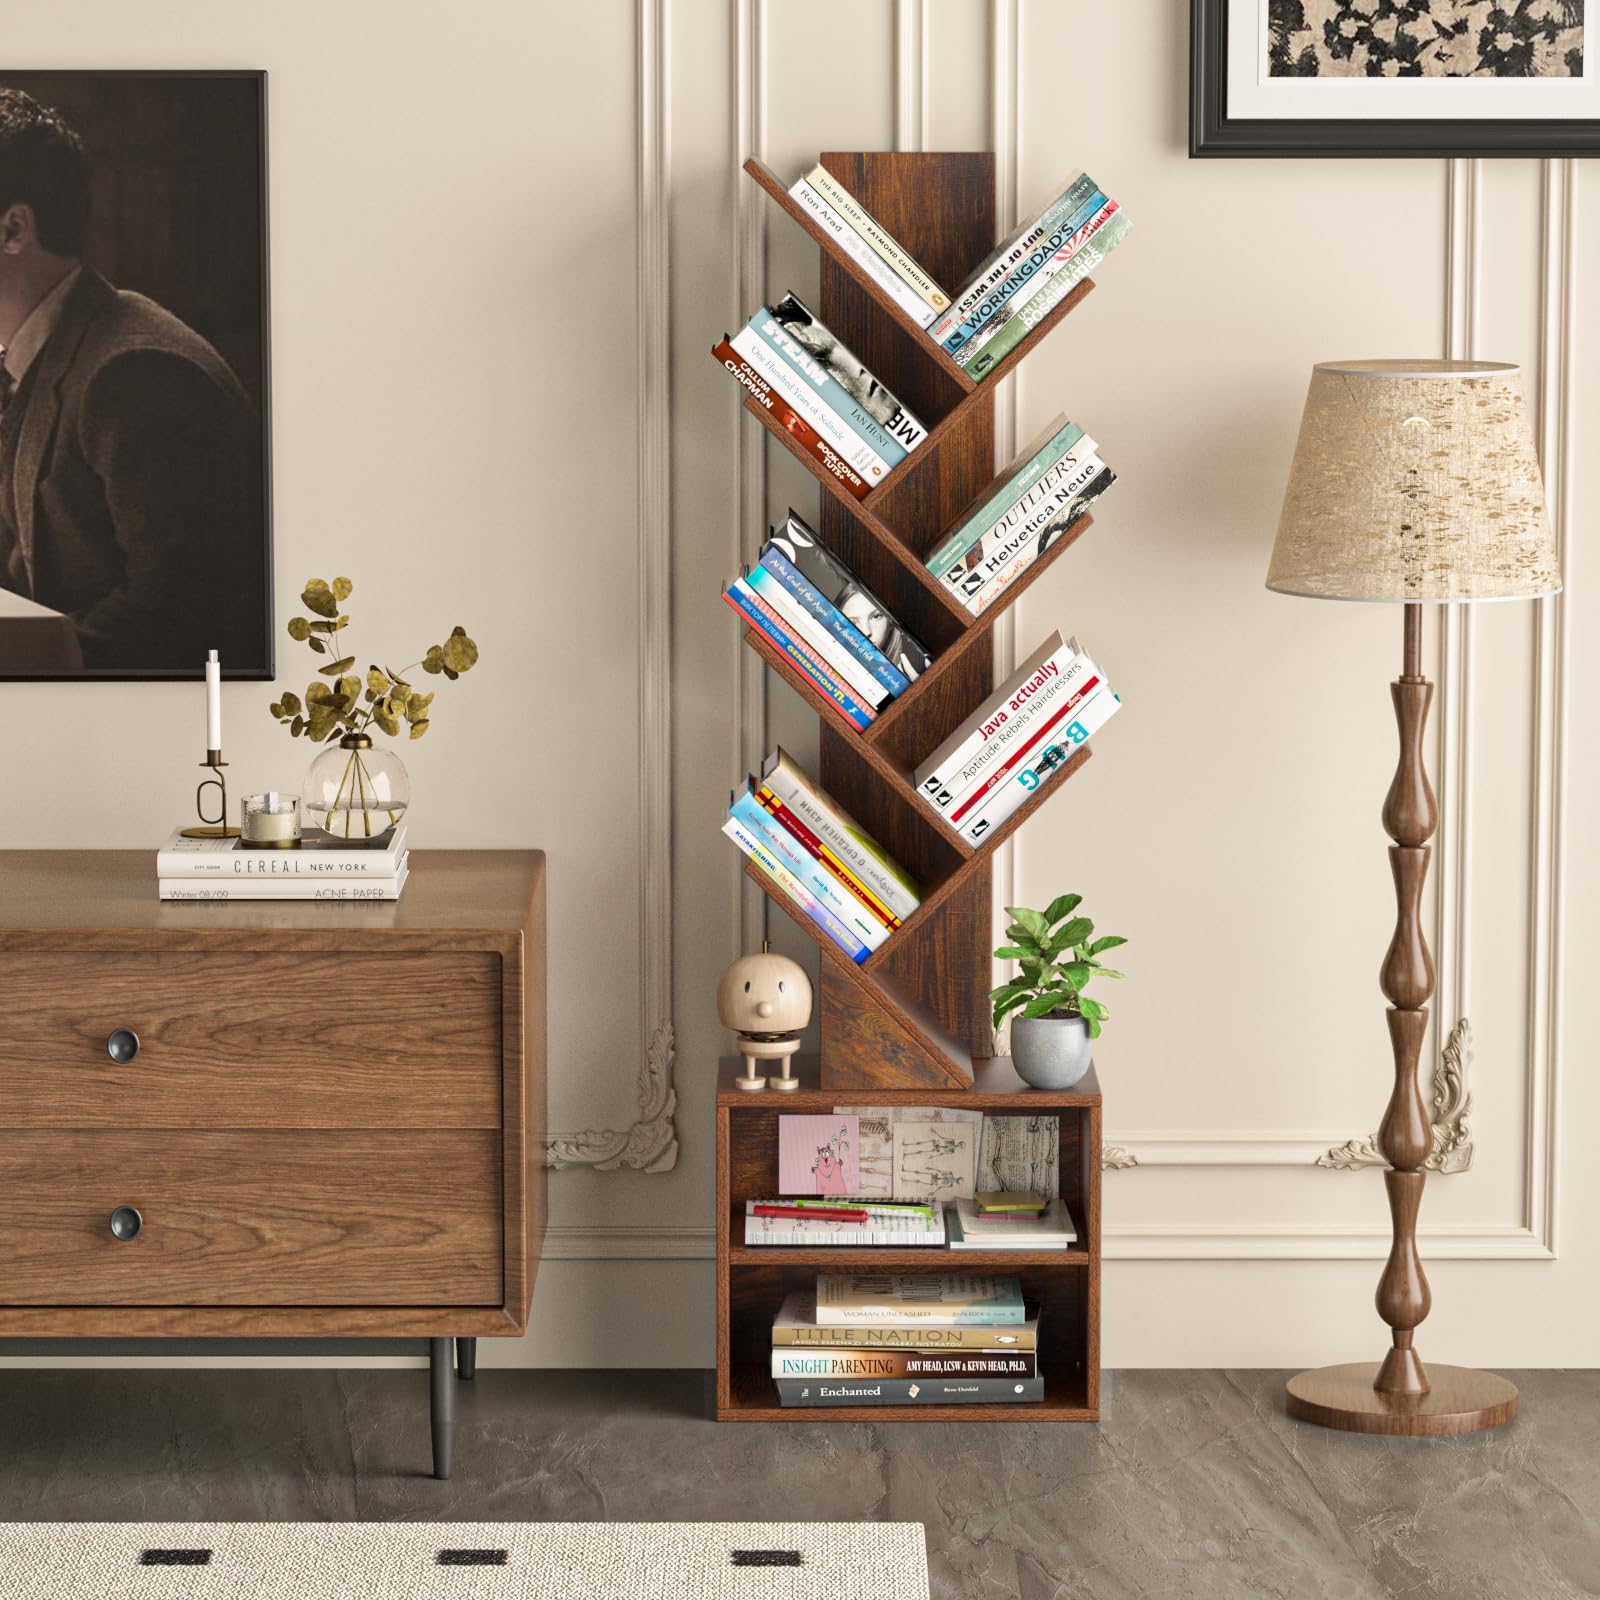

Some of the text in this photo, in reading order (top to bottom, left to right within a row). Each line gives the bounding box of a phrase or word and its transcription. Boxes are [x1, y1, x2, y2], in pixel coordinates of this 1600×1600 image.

[799, 188, 843, 232] Ron Arad
[1070, 181, 1089, 200] KEVIN
[819, 177, 832, 191] THE
[831, 190, 844, 203] BIG
[843, 202, 862, 221] SLEEP
[866, 226, 898, 259] RAYMOND
[897, 257, 930, 291] CHANDLER
[1080, 203, 1115, 238] Black
[956, 226, 1045, 315] OUT OF THE WEST
[964, 259, 1036, 332] WORKING
[1029, 221, 1075, 267] DAD'S
[1016, 242, 1096, 321] UNIMAGINABLE
[1022, 248, 1105, 330] POSSIBILITIES
[760, 318, 829, 387] STEAM
[722, 358, 774, 409] CHAPMAN
[738, 361, 771, 394] CALLUM
[749, 345, 846, 441] One Hundred Years of Solitude
[850, 408, 890, 448] IAN HUNT
[815, 441, 839, 464] BOOK
[835, 460, 861, 486] COVER
[820, 455, 846, 481] TUTS+
[983, 501, 1056, 573] Helvetica
[1053, 460, 1097, 504] Neue
[988, 450, 1081, 540] OUTLIERS
[776, 564, 788, 576] the
[785, 573, 801, 589] End
[795, 584, 807, 596] of
[803, 590, 815, 603] the
[810, 599, 829, 618] Ages
[832, 620, 843, 631] The
[739, 597, 787, 645] ВИКТОР ПЕЛЕВИН
[785, 643, 834, 692] GENERATION
[959, 660, 1082, 782] Aptitude Rebels Hairdressers
[975, 658, 1062, 741] Java actually
[797, 799, 823, 825] АЗИИ
[819, 820, 860, 860] СРЕДНЕЙ
[234, 860, 300, 873] CEREAL
[338, 863, 367, 871] YORK
[315, 888, 384, 898] ACNE PAPER
[792, 1328, 963, 1341] TITLE NATION
[783, 1359, 894, 1374] INSIGHT PARENTING
[906, 1360, 1027, 1373] AMY HEAD, LCSW & KEVIN HEAD, PH.D.
[820, 1386, 881, 1397] Enchanted
